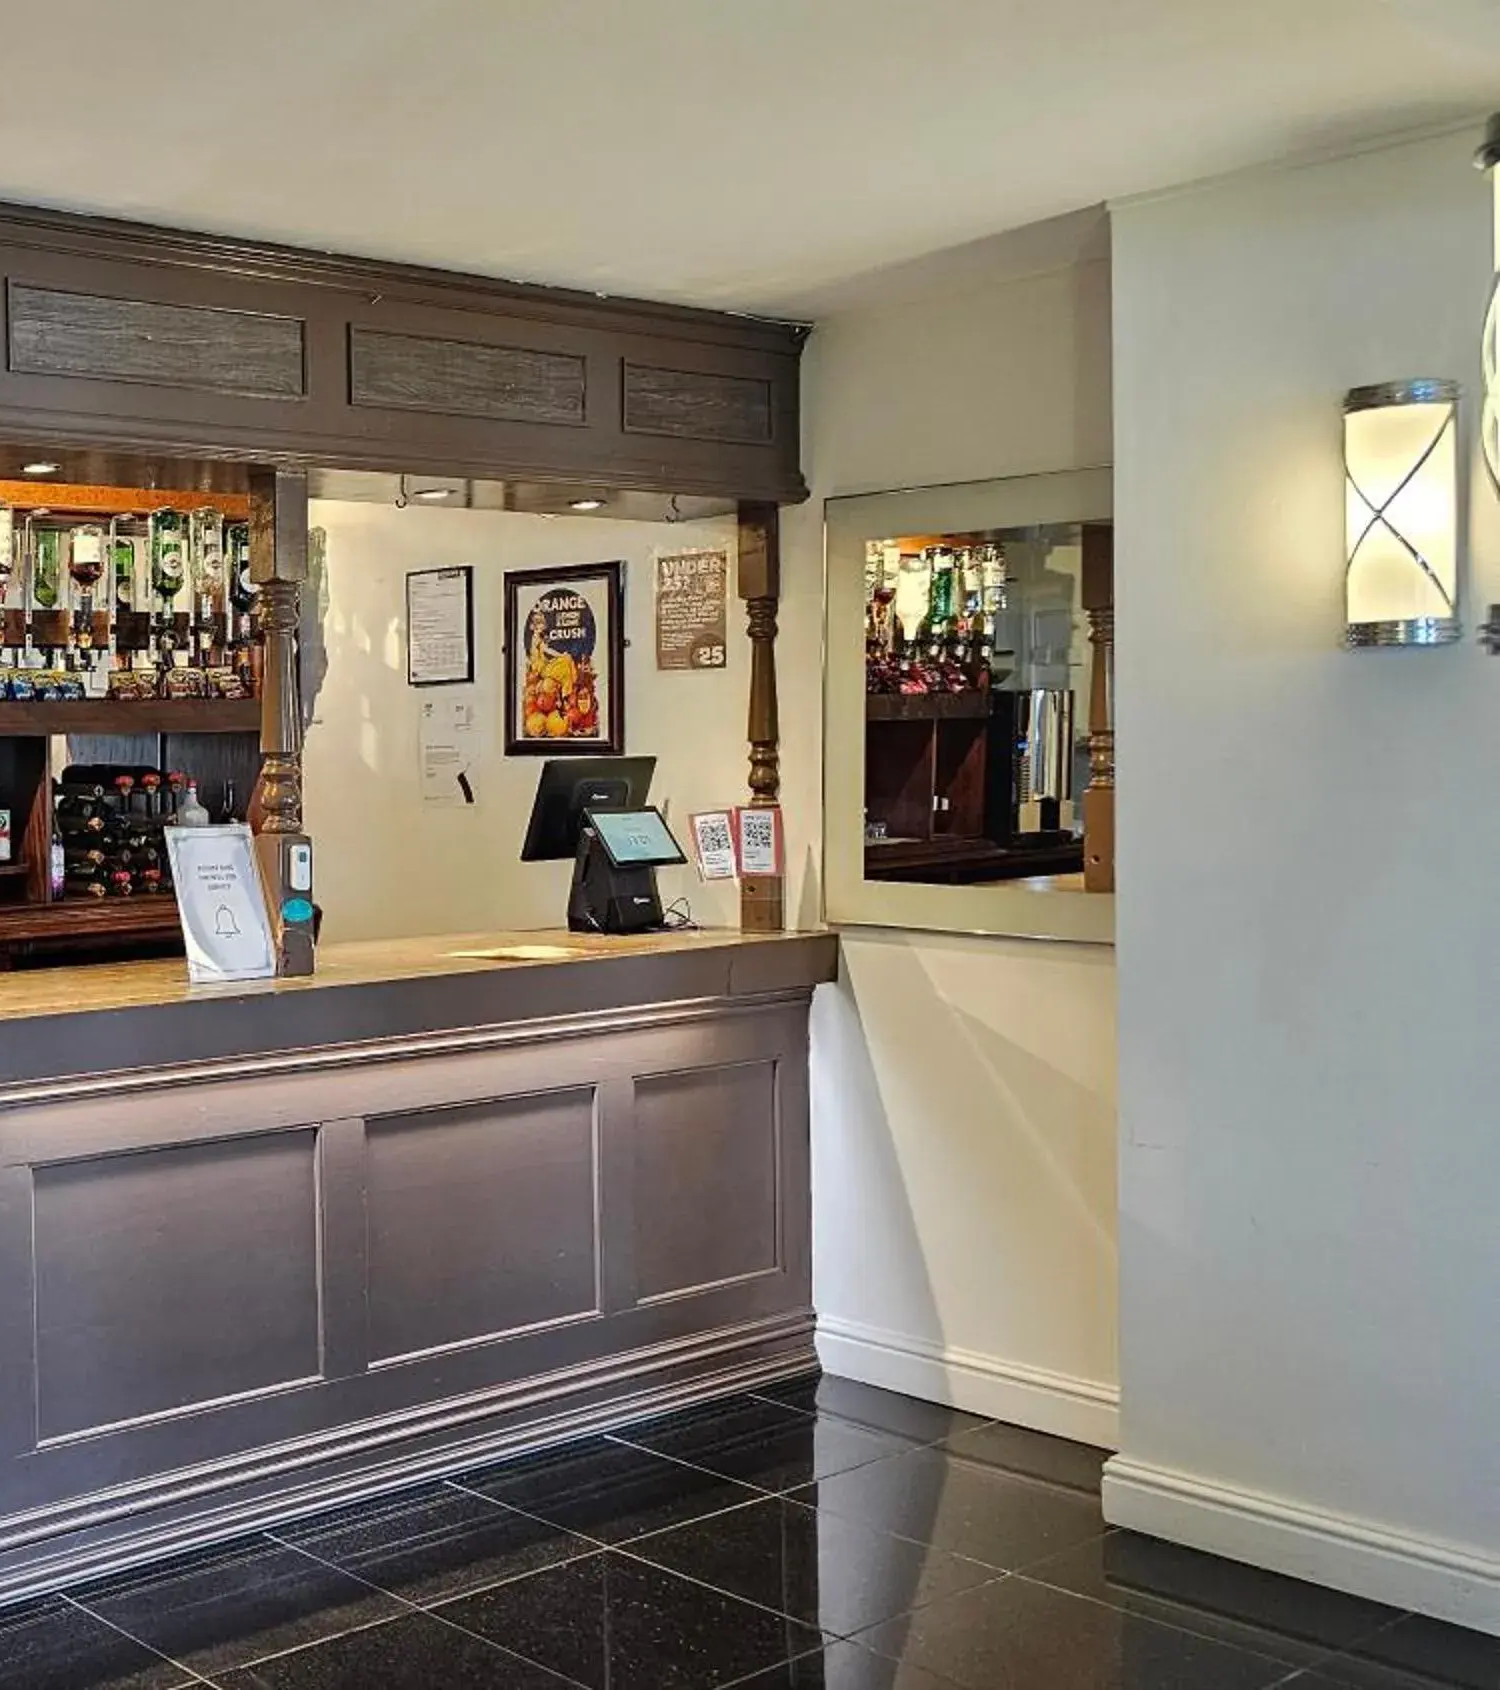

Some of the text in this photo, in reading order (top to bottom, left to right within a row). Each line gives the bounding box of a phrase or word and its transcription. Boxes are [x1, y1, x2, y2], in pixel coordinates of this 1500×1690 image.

[661, 559, 721, 577] UNDER
[533, 596, 587, 612] ORANGE
[549, 628, 587, 640] CRUSH
[699, 645, 724, 665] 25
